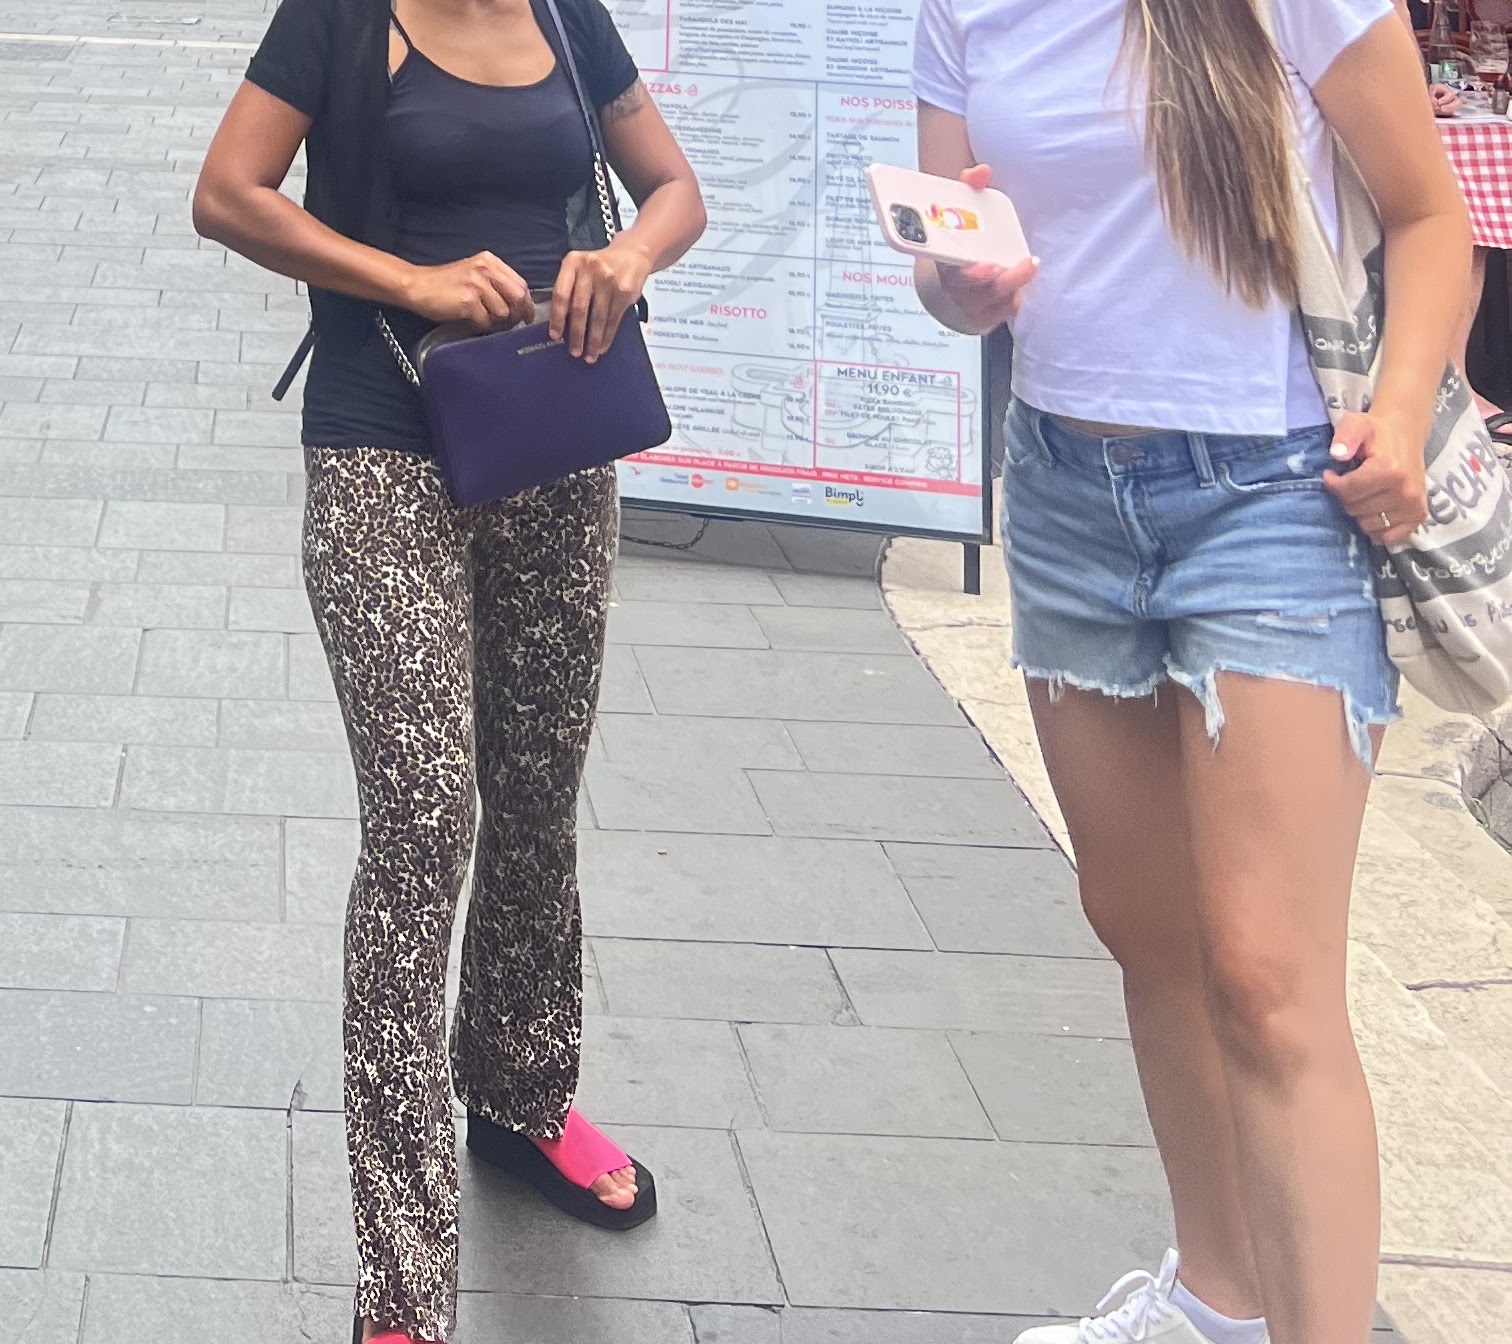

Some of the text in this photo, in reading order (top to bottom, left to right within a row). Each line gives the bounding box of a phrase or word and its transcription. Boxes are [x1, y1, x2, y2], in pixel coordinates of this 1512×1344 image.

[648, 82, 682, 94] ZZAS
[840, 96, 870, 108] NOS
[842, 272, 873, 284] NOS
[710, 304, 767, 320] RISOTTO
[837, 367, 936, 384] MENU ENFANT
